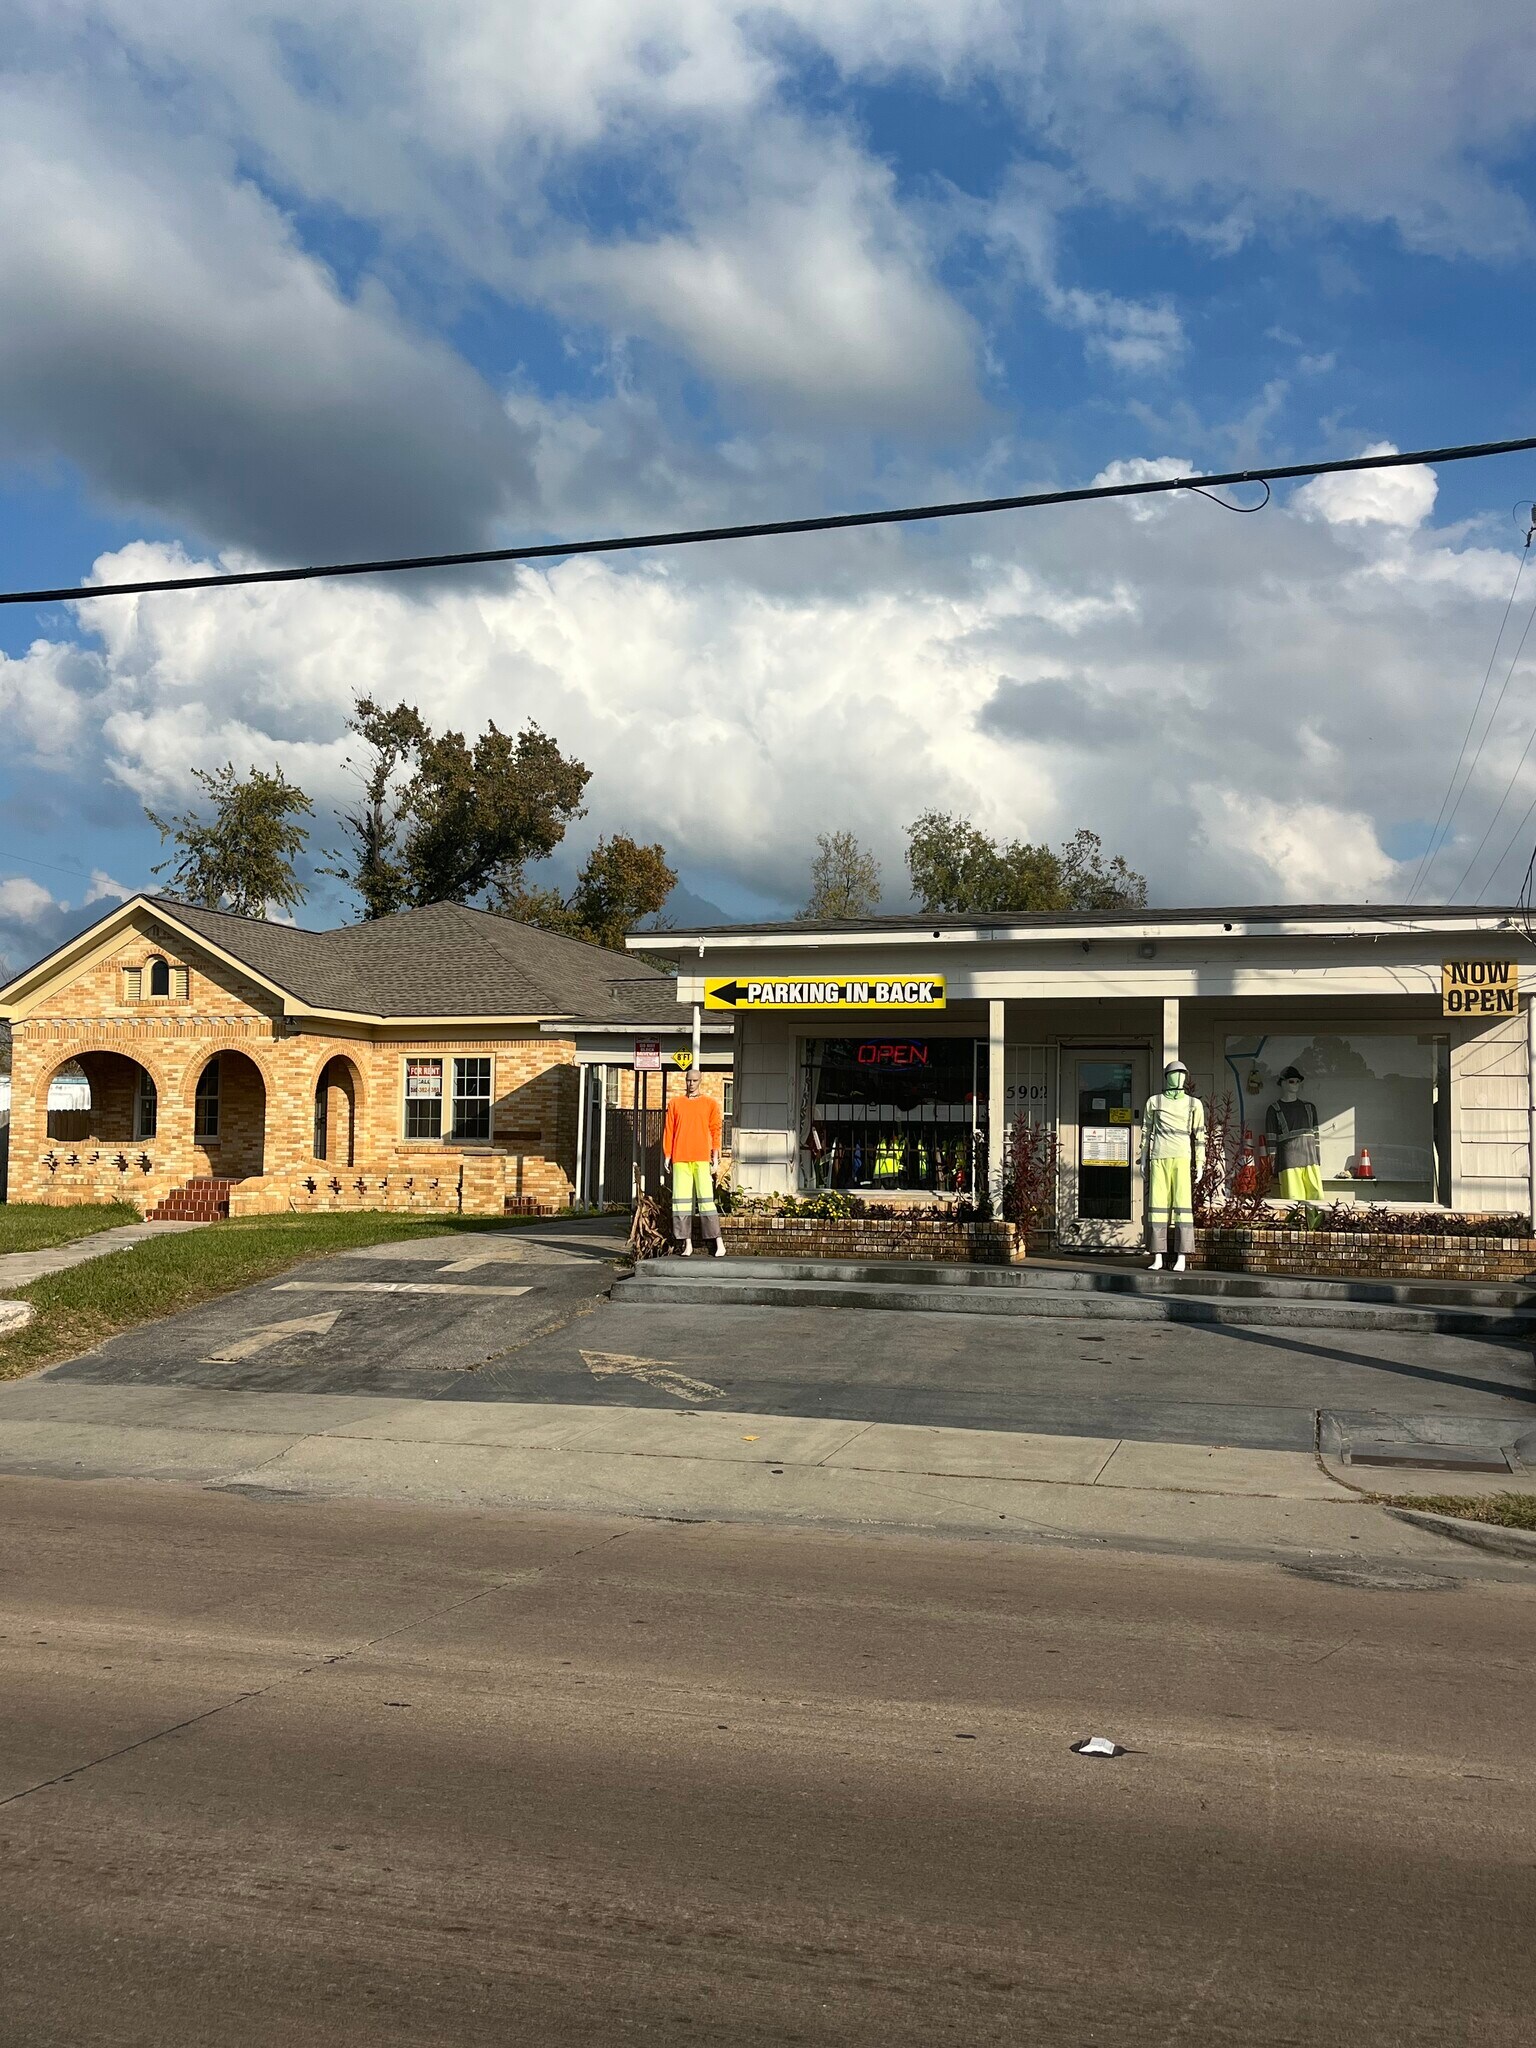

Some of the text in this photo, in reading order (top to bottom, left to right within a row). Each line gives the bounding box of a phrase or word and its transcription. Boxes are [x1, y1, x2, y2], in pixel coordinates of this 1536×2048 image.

[1451, 961, 1510, 984] NOW
[747, 982, 935, 1003] PARKING IN BACK
[1448, 989, 1514, 1012] OPEN
[857, 1045, 928, 1064] OPEN
